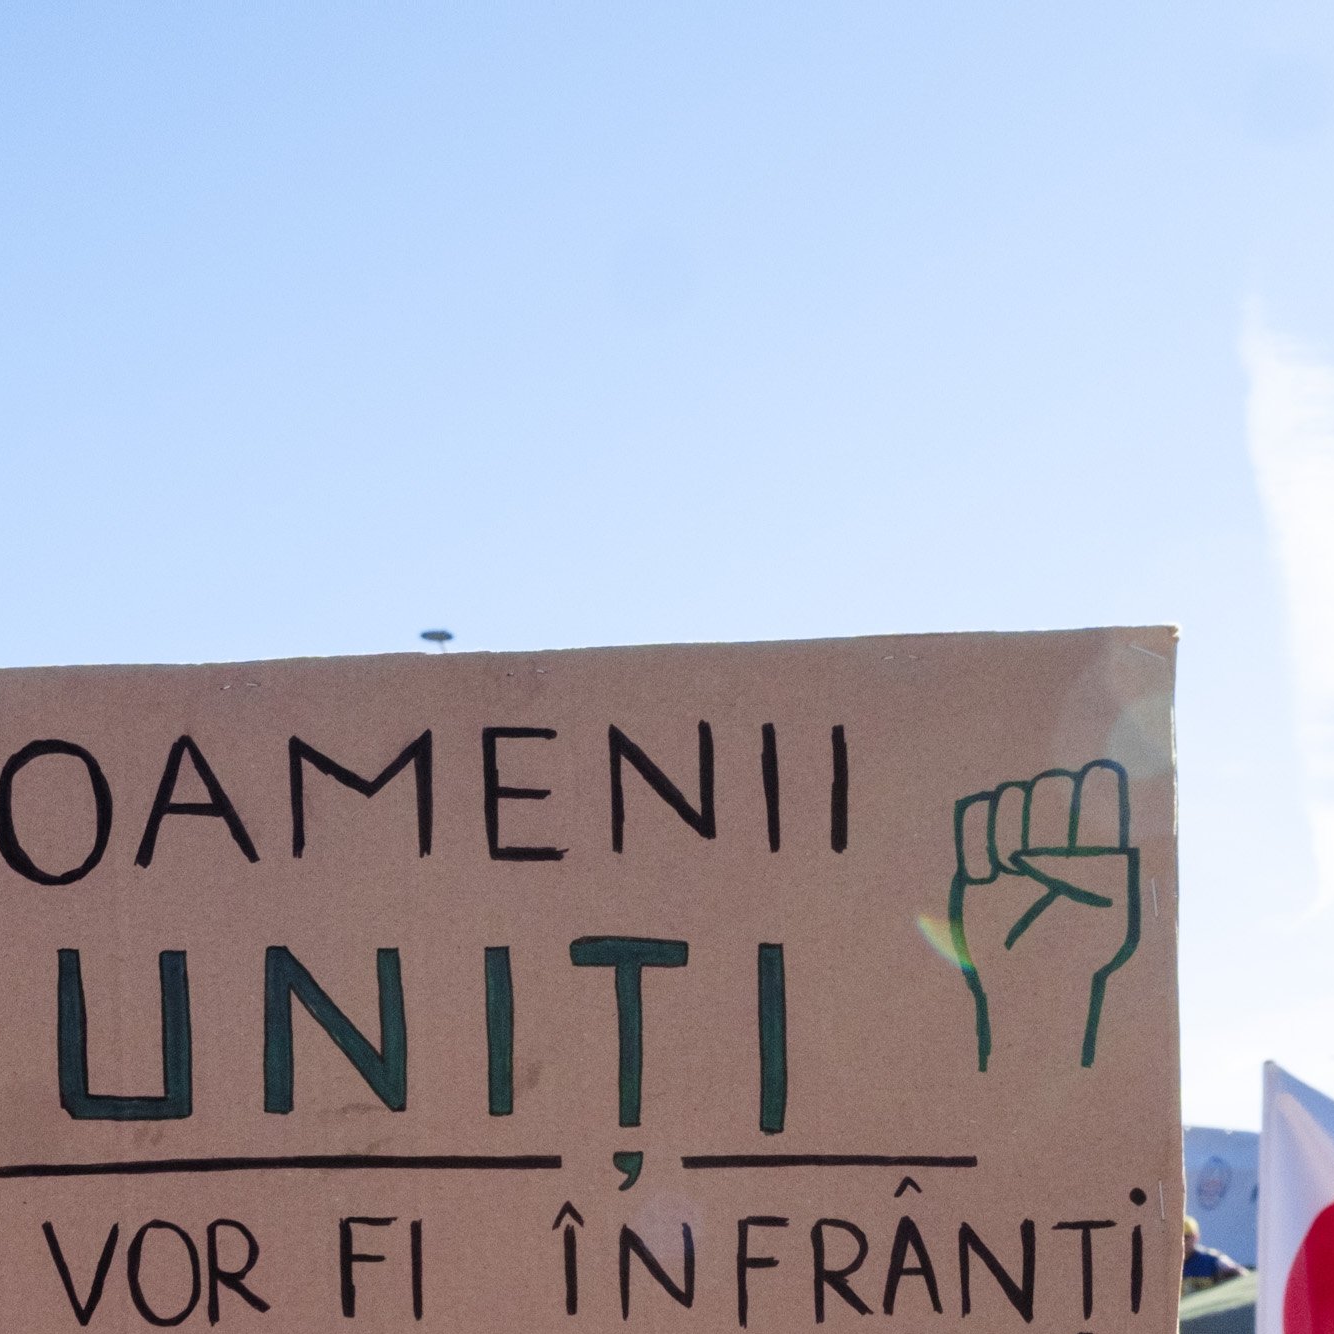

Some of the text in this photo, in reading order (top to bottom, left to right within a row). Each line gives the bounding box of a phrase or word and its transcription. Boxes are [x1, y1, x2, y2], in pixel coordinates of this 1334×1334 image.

[56, 935, 788, 1191] UNIȚI
[41, 1218, 271, 1328] VOR
[339, 1215, 424, 1322] FI
